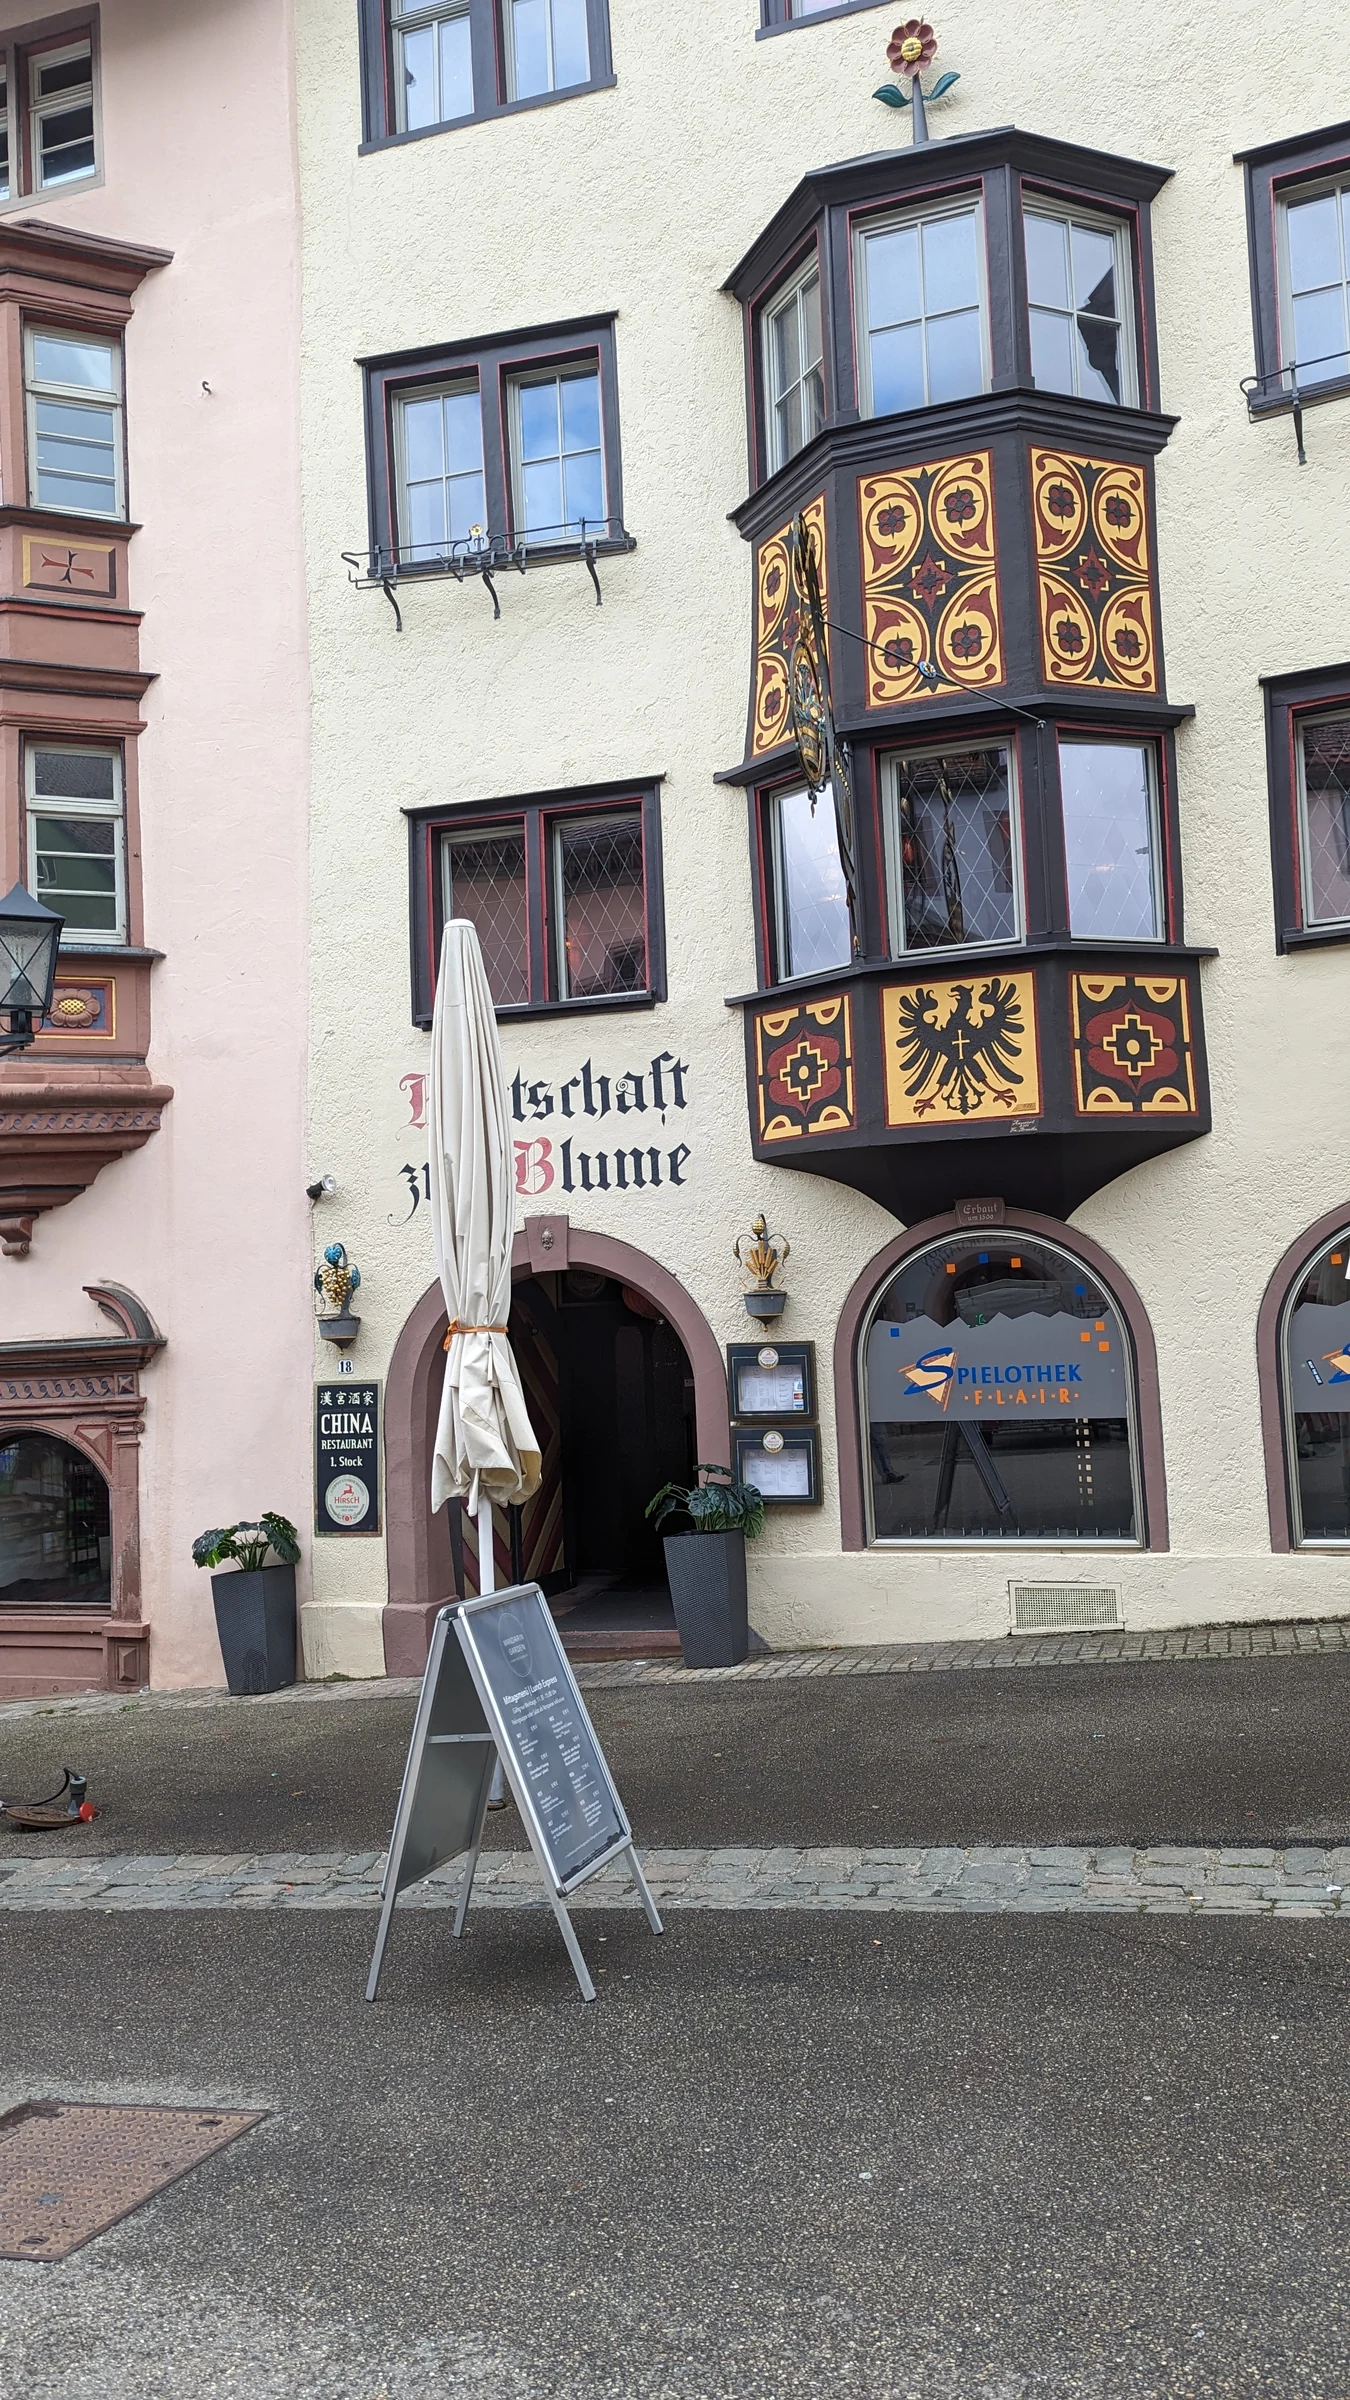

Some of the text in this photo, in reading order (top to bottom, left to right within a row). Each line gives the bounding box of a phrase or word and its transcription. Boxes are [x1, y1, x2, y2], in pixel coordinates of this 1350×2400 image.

[513, 1135, 692, 1195] Blume
[963, 1203, 998, 1214] Erbaut
[340, 1361, 352, 1373] 18
[903, 1346, 1083, 1396] SPIELOTHEK
[321, 1412, 374, 1435] CHINA
[321, 1438, 374, 1450] RESTAURANT
[330, 1455, 363, 1467] 1. Stock
